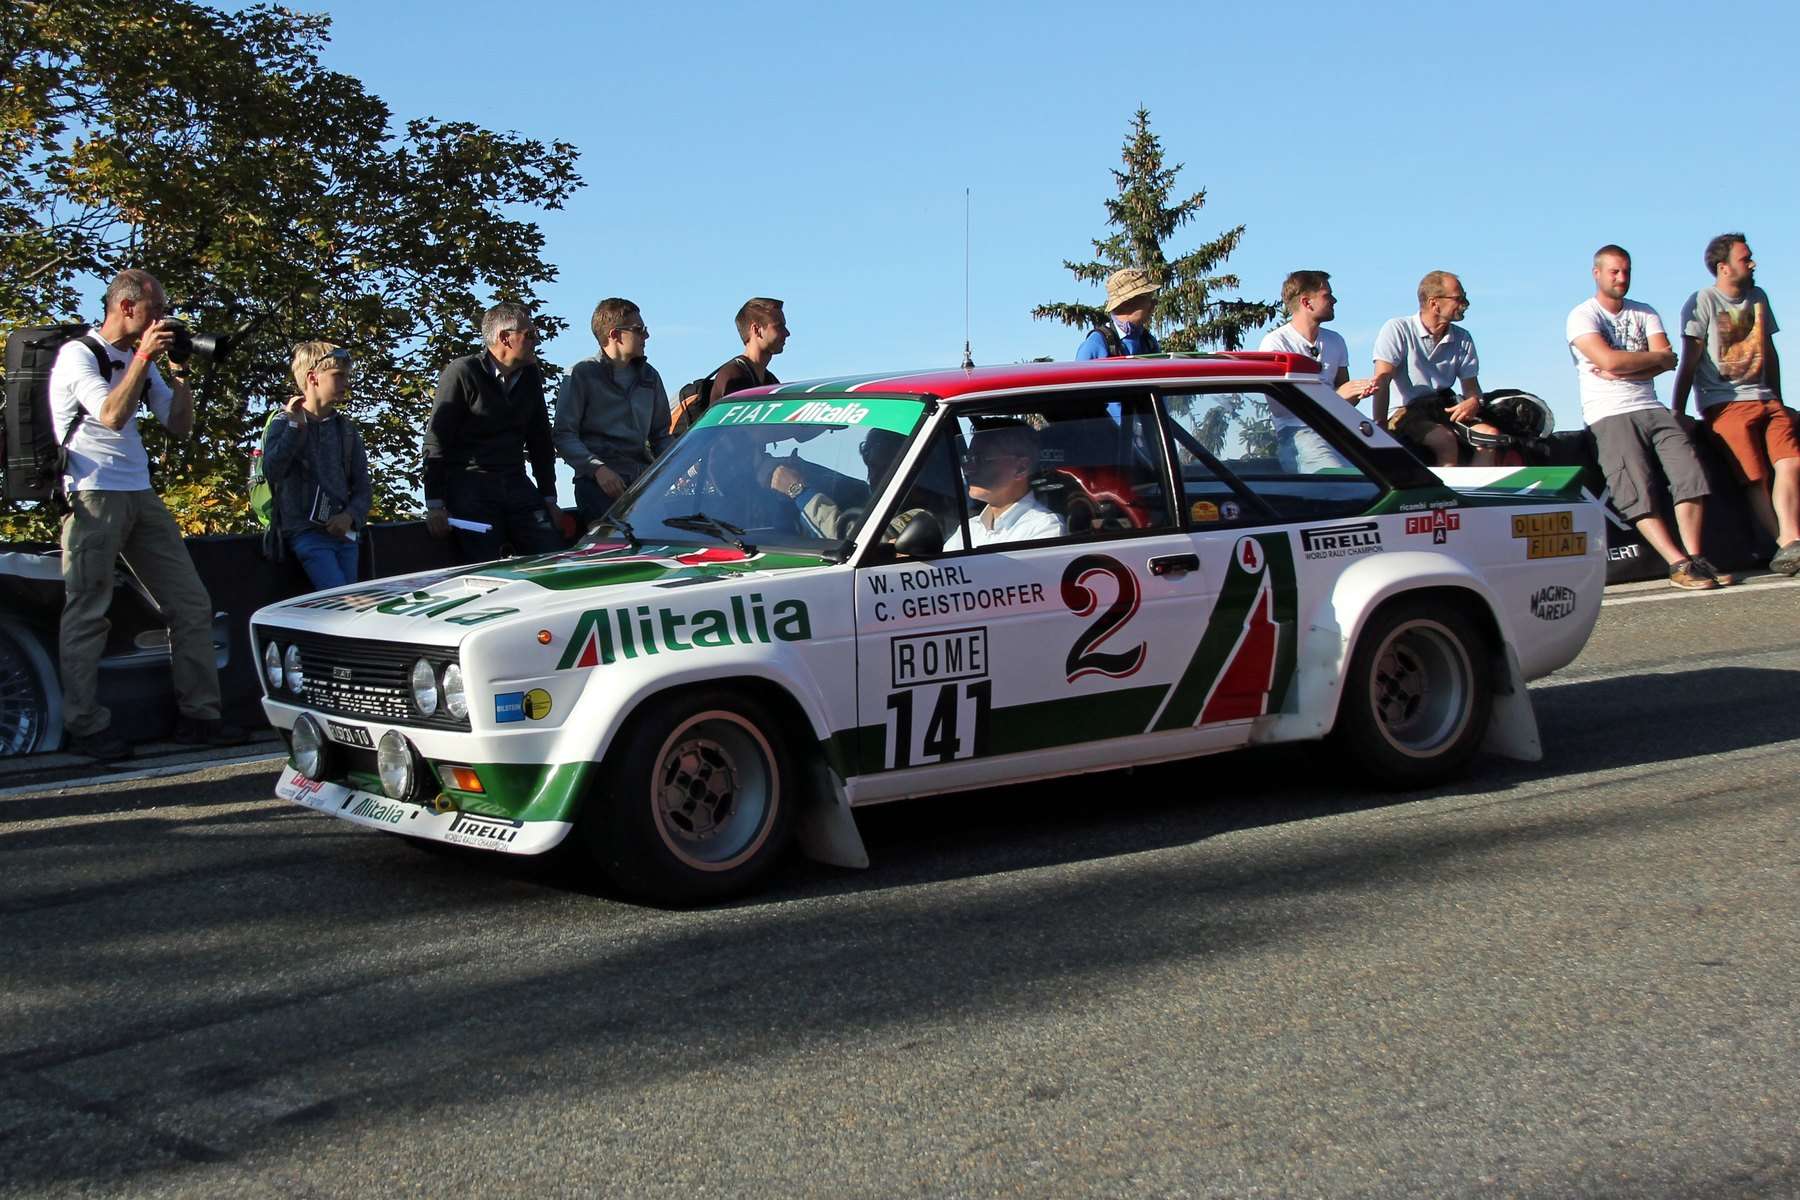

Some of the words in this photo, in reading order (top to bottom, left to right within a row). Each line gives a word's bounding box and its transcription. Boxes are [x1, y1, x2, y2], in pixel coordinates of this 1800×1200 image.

[719, 403, 783, 424] FIAT
[784, 402, 869, 424] Alitalia
[1300, 522, 1382, 551] PIRELLI
[1409, 513, 1458, 533] FIAT
[1515, 515, 1570, 534] OLIO
[1243, 540, 1258, 568] 4
[1305, 552, 1328, 560] WORLD
[1328, 550, 1345, 558] RALLY
[1347, 545, 1384, 556] CHAMPION
[1532, 536, 1585, 554] FIAT
[1607, 544, 1639, 561] ERT
[868, 574, 895, 595] W.
[900, 566, 973, 591] ROHRL
[874, 602, 896, 622] C.
[902, 583, 1046, 619] GEISTDORFER
[555, 593, 812, 670] Alitalia
[1061, 554, 1147, 684] 2
[898, 635, 982, 680] ROME
[884, 679, 992, 768] 141
[351, 797, 405, 824] Alitalia
[449, 810, 524, 843] PIRELLI
